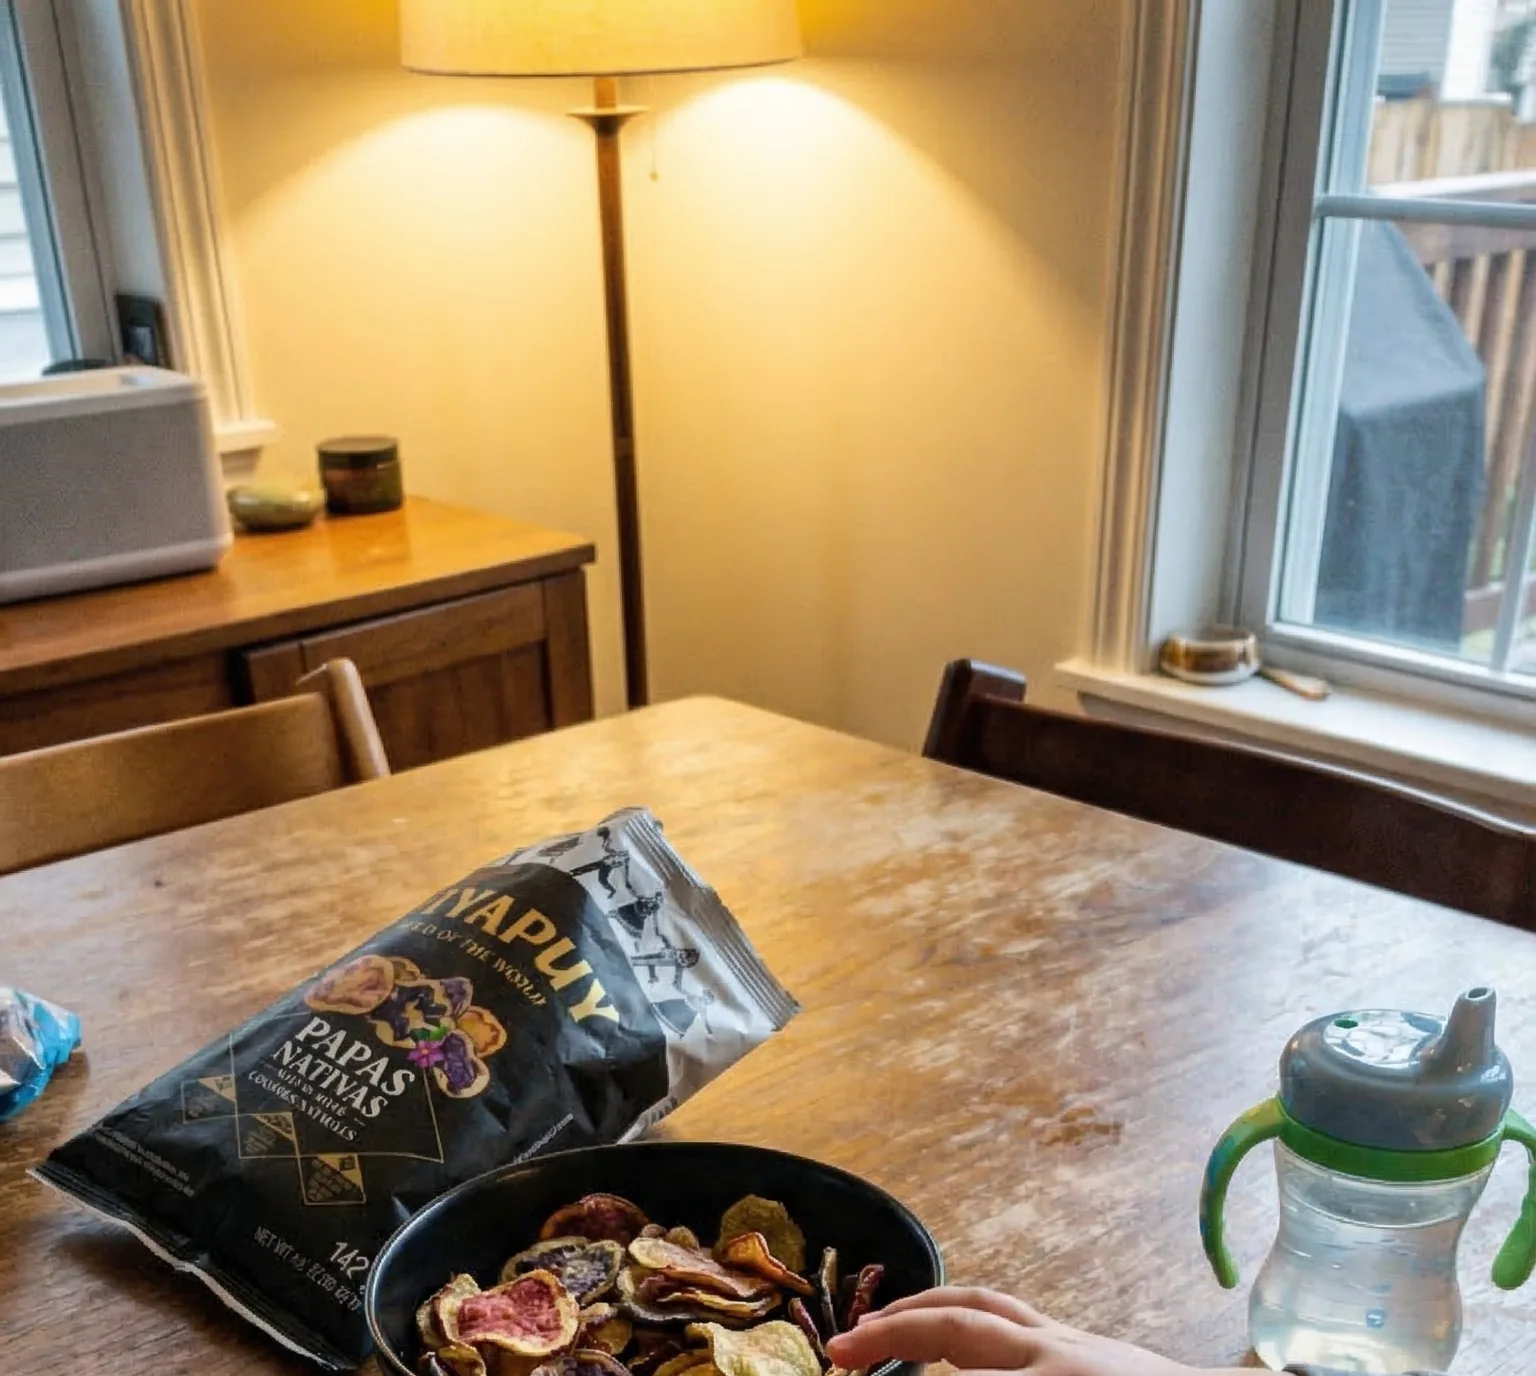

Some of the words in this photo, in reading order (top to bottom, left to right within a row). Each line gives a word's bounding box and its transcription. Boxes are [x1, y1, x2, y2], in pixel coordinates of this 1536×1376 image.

[272, 1040, 389, 1118] NATIVAS
[295, 1016, 415, 1096] PAPAS
[330, 1242, 370, 1280] 142
